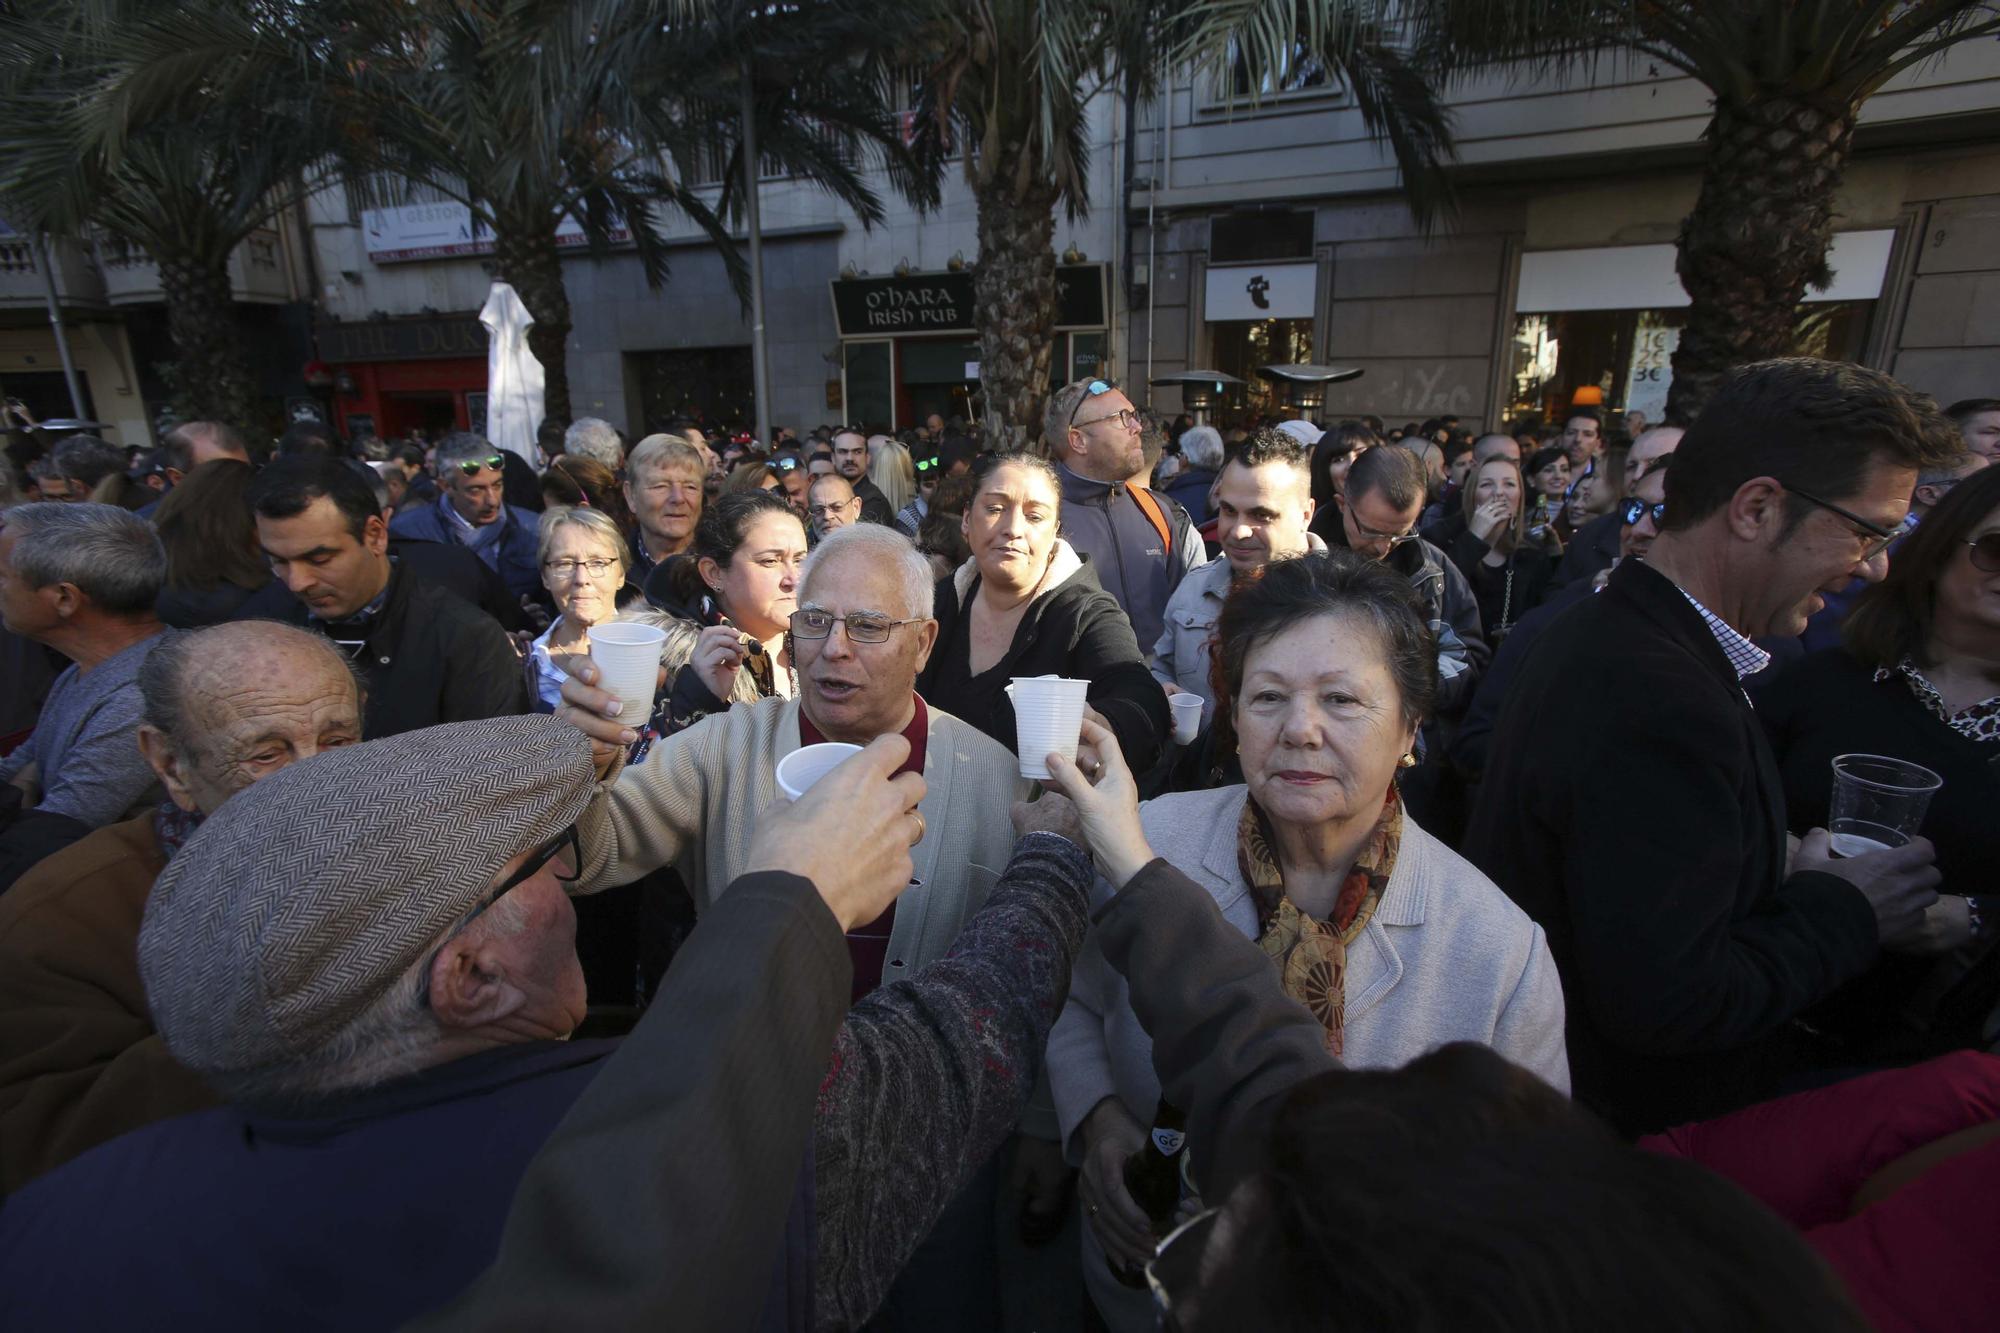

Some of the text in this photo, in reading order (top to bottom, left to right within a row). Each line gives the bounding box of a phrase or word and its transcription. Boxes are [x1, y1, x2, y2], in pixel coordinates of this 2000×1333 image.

[920, 307, 958, 324] PUB
[340, 321, 487, 356] THE DUK
[1633, 367, 1662, 383] 3€
